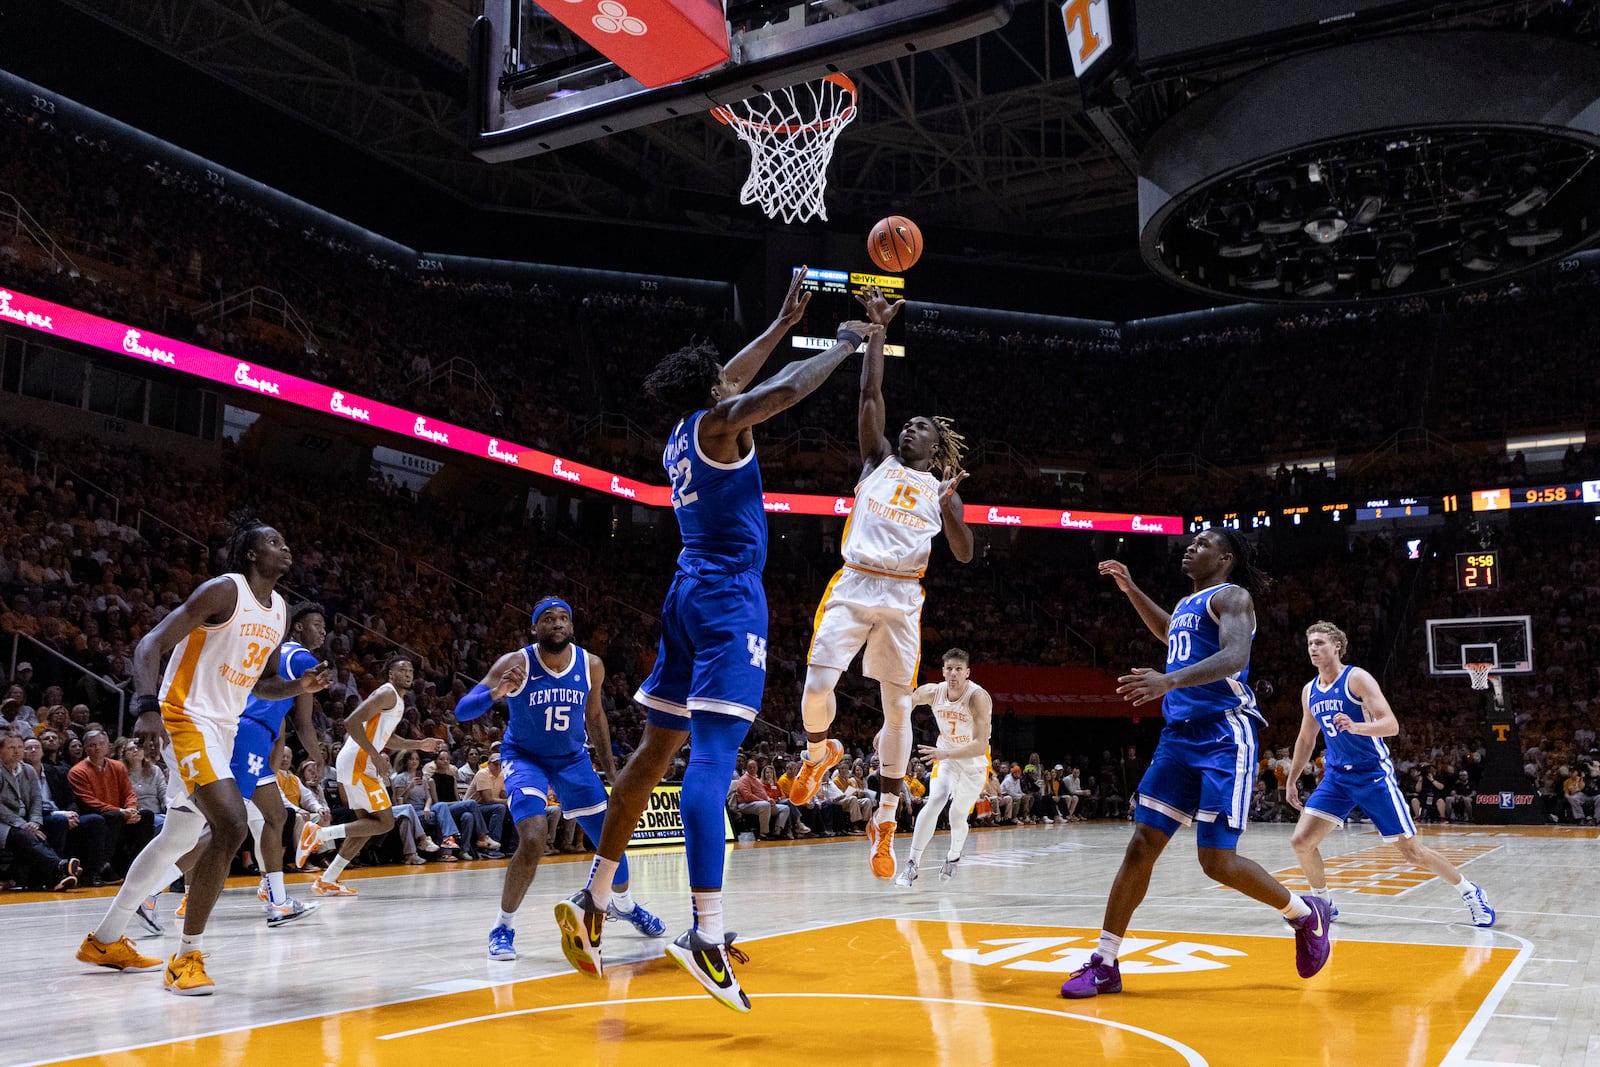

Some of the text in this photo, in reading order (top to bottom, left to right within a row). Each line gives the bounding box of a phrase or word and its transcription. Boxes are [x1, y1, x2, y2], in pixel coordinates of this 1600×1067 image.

[31, 94, 56, 114] 323
[876, 230, 893, 262] ELITE
[417, 258, 444, 273] 325A
[639, 279, 658, 291] 325
[922, 308, 940, 320] 327
[669, 457, 698, 510] 22
[889, 482, 921, 510] 15
[1367, 499, 1388, 508] FOULS
[1442, 494, 1457, 512] 11
[1481, 490, 1501, 510] T
[1526, 487, 1567, 504] 9:58
[867, 497, 928, 530] VOLUNTEERS
[1333, 510, 1340, 521] 2
[1375, 508, 1382, 518] 2
[1405, 506, 1411, 516] 4
[1467, 555, 1494, 567] 9:58
[1465, 567, 1492, 587] 21
[1167, 630, 1191, 664] 00
[242, 641, 271, 672] 34
[529, 687, 585, 706] KENTUCKY
[544, 706, 571, 731] 15
[948, 721, 956, 735] 7
[1492, 724, 1510, 741] T
[180, 751, 201, 779] T
[369, 789, 384, 804] T
[1476, 795, 1534, 804] FOOD CITY
[647, 811, 683, 828] DRIVE
